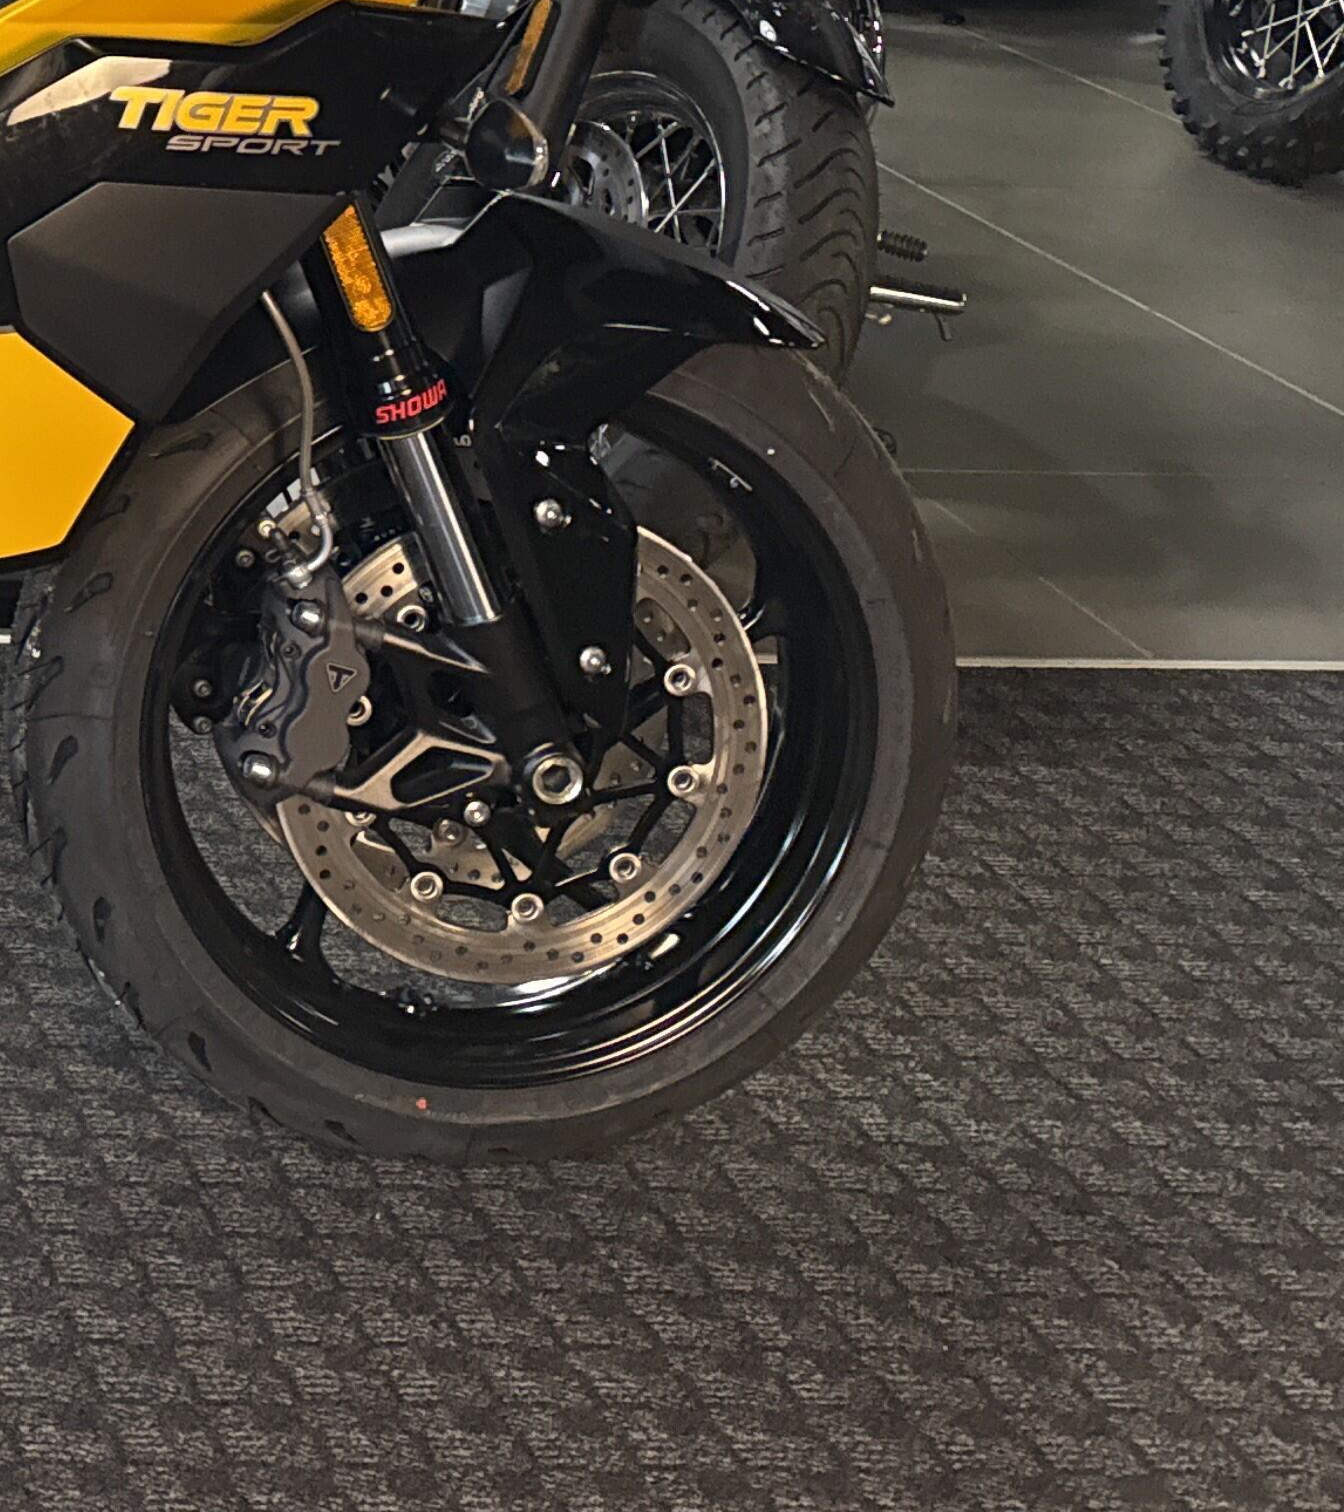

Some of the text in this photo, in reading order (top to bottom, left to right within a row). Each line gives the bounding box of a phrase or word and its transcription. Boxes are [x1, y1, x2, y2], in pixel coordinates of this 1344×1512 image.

[109, 85, 320, 139] TIGER
[165, 134, 342, 157] SPORT
[375, 378, 449, 425] SHOWA
